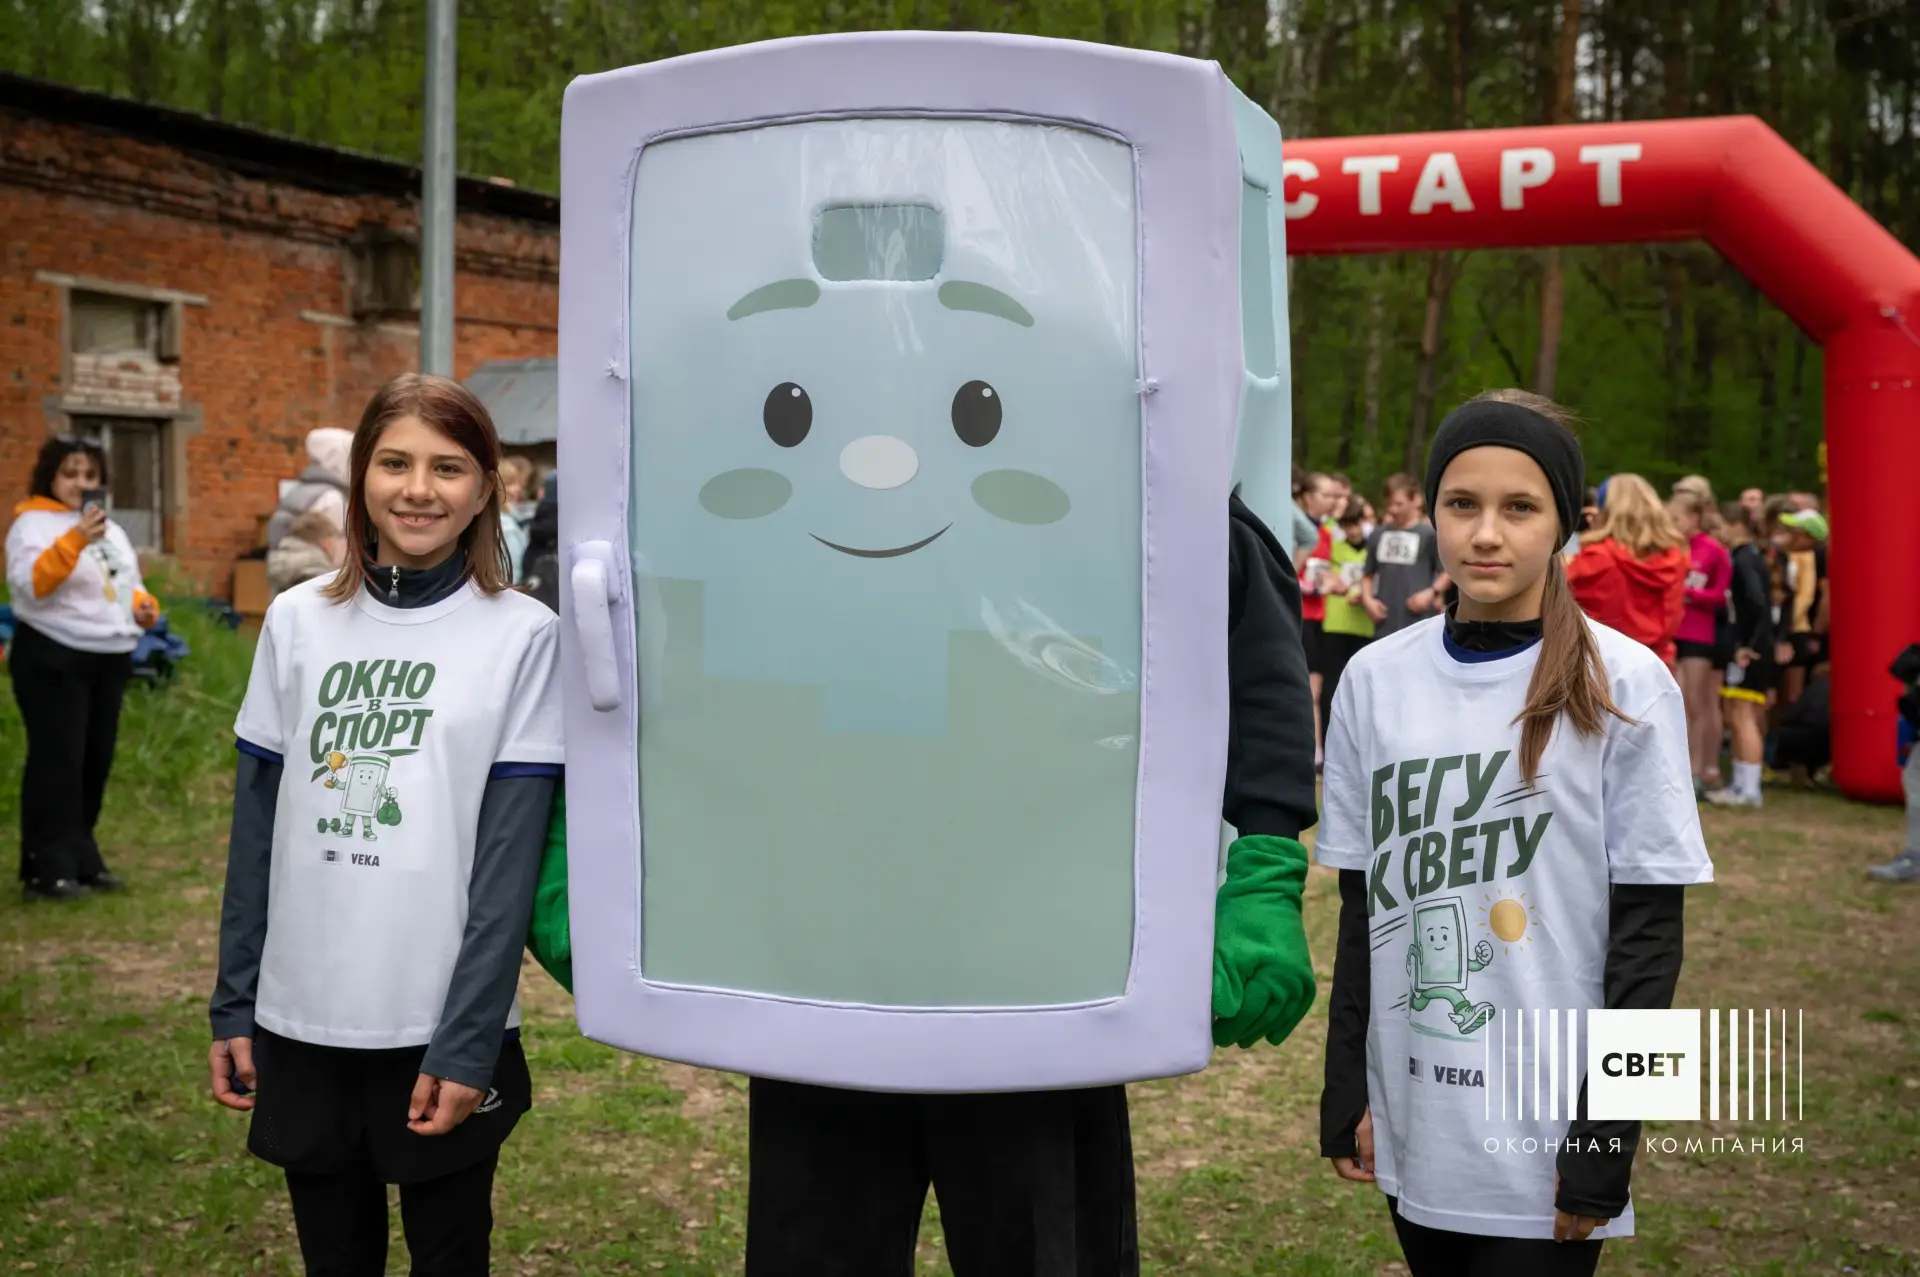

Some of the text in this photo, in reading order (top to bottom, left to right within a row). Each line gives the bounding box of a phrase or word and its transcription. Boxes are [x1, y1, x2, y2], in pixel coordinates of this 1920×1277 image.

[1282, 143, 1642, 220] СТАРТ
[318, 659, 436, 708] ОКНО
[310, 709, 434, 764] СПОРТ
[1371, 750, 1512, 851] БЕГУ
[351, 853, 380, 867] VEKA
[1368, 812, 1554, 918] К СВЕТУ
[1433, 1064, 1485, 1088] VEKA
